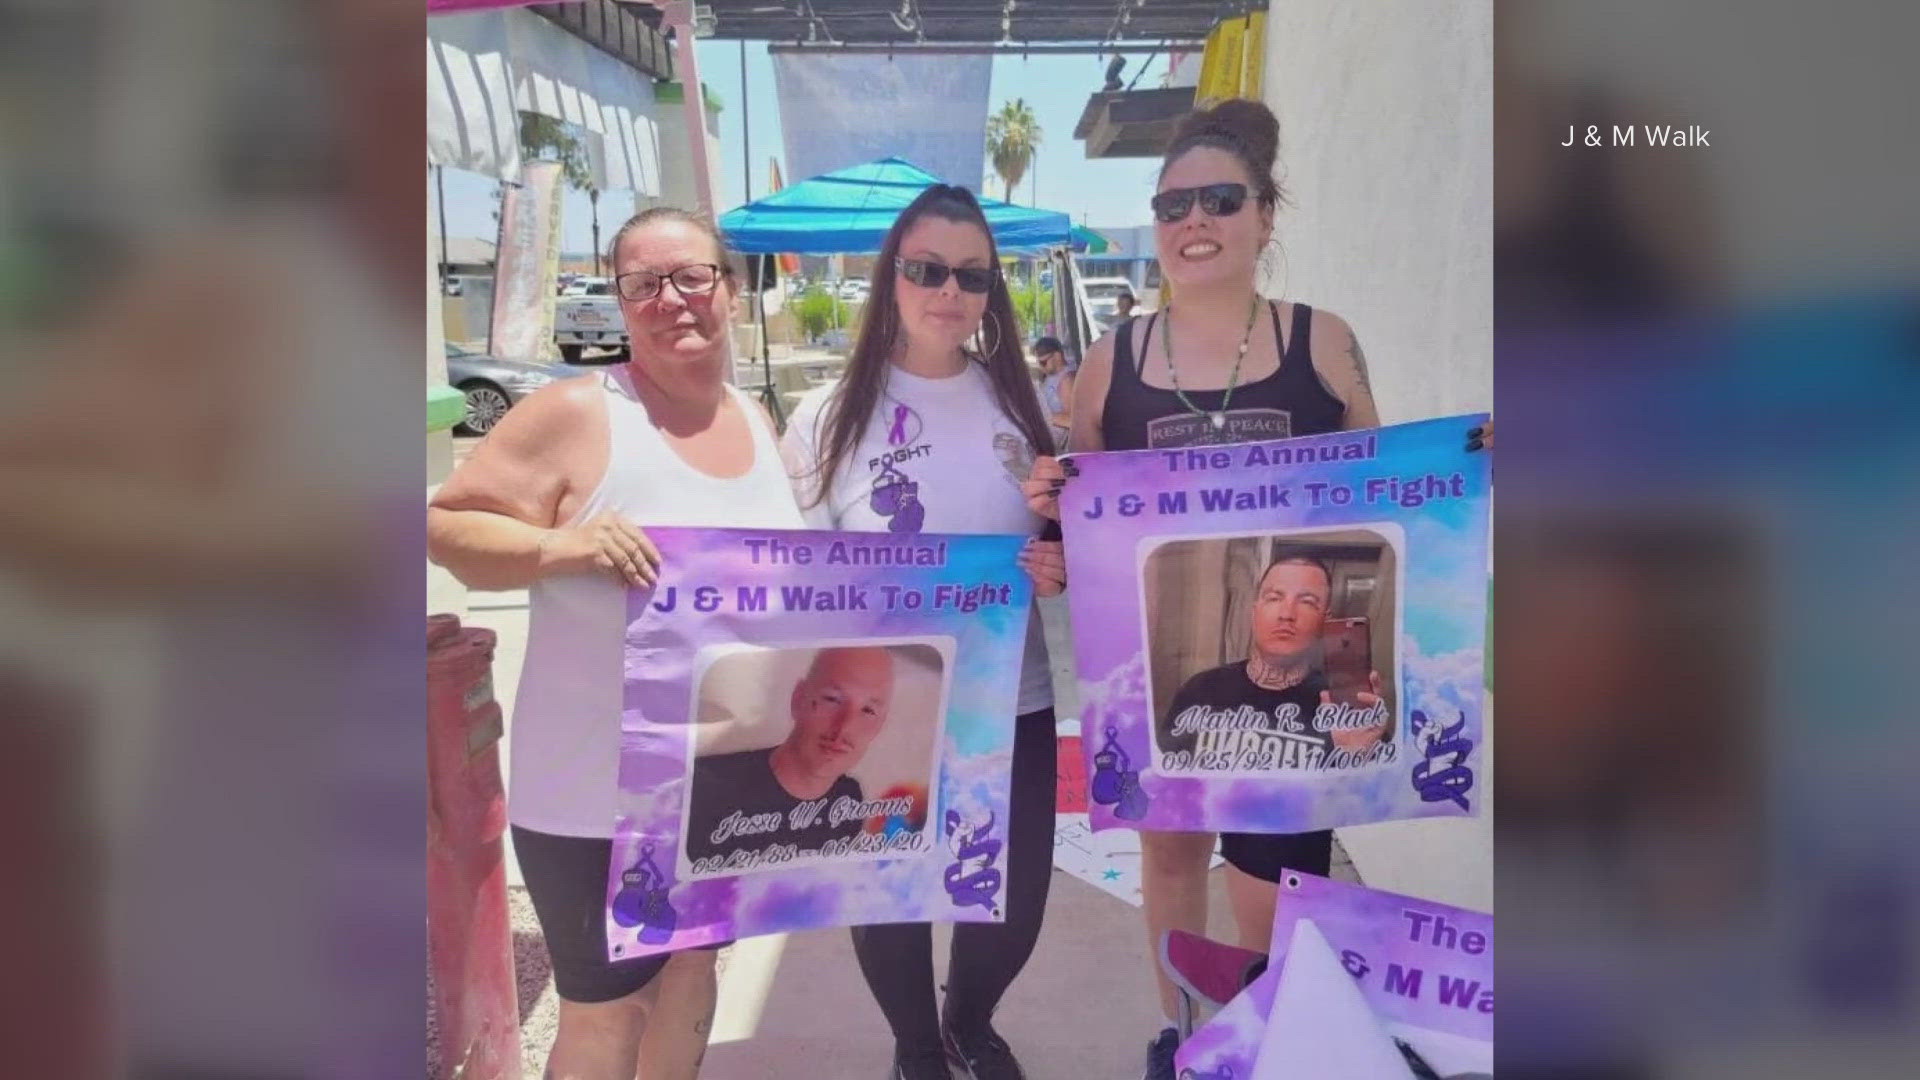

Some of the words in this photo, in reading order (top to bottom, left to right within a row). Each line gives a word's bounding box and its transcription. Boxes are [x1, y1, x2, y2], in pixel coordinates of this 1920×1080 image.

[1153, 423, 1197, 441] REST
[1228, 419, 1287, 433] PEACE
[1162, 449, 1231, 473] The
[1244, 436, 1377, 467] Annual
[1083, 496, 1104, 520] J
[1117, 493, 1146, 517] &
[1158, 490, 1187, 515] M
[1200, 483, 1292, 513] Walk
[1303, 481, 1353, 507] To
[1365, 472, 1464, 508] Fight
[744, 538, 813, 565] The
[826, 540, 947, 567] Annual
[653, 585, 677, 613] J
[693, 585, 724, 613] &
[736, 585, 768, 612] M
[781, 584, 869, 612] Walk
[880, 585, 922, 611] To
[934, 582, 1012, 614] Fight
[1171, 704, 1269, 736] Marlin
[1275, 703, 1305, 732] R.
[1312, 698, 1389, 732] Black
[1162, 750, 1273, 774] 09/25/92
[829, 795, 914, 829] Grooms
[1402, 908, 1487, 956] The
[1383, 962, 1424, 999] M
